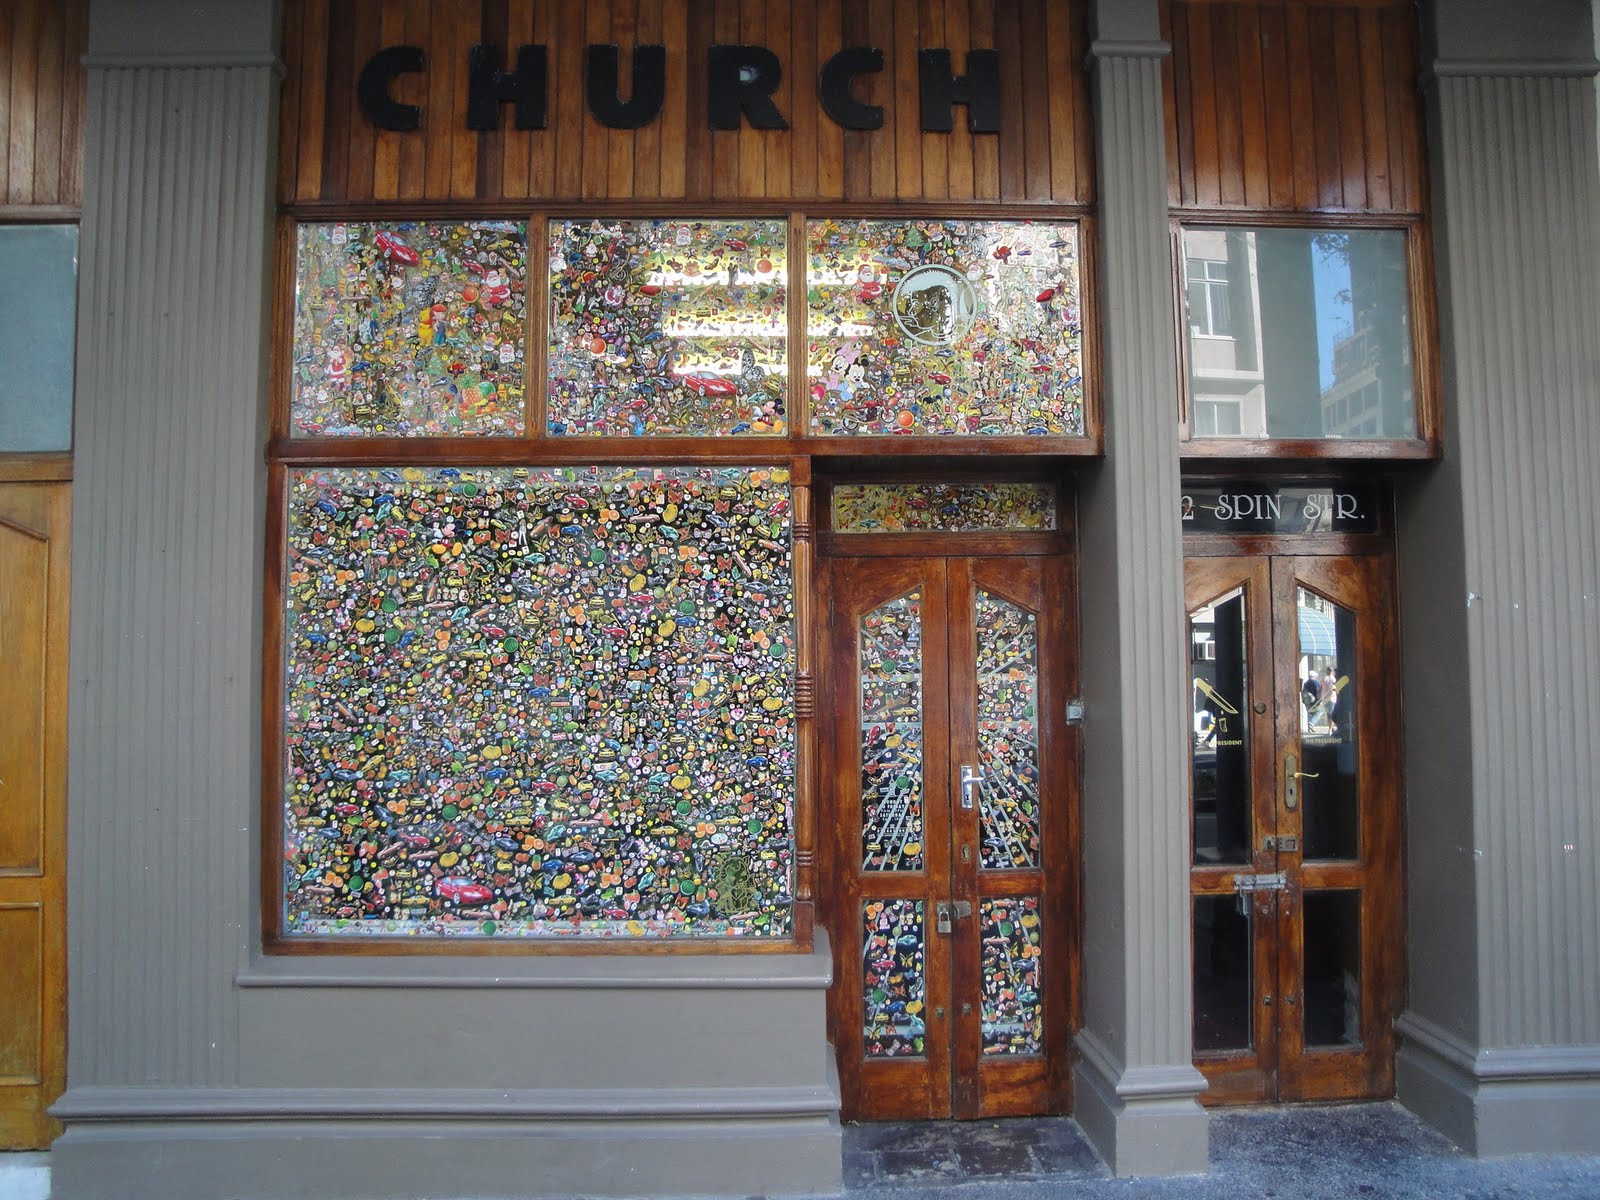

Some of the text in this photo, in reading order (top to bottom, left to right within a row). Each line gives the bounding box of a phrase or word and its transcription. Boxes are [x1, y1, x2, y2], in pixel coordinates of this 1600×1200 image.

[358, 44, 999, 133] CHURCH
[1214, 494, 1282, 520] SPIN
[1303, 494, 1365, 520] STR.
